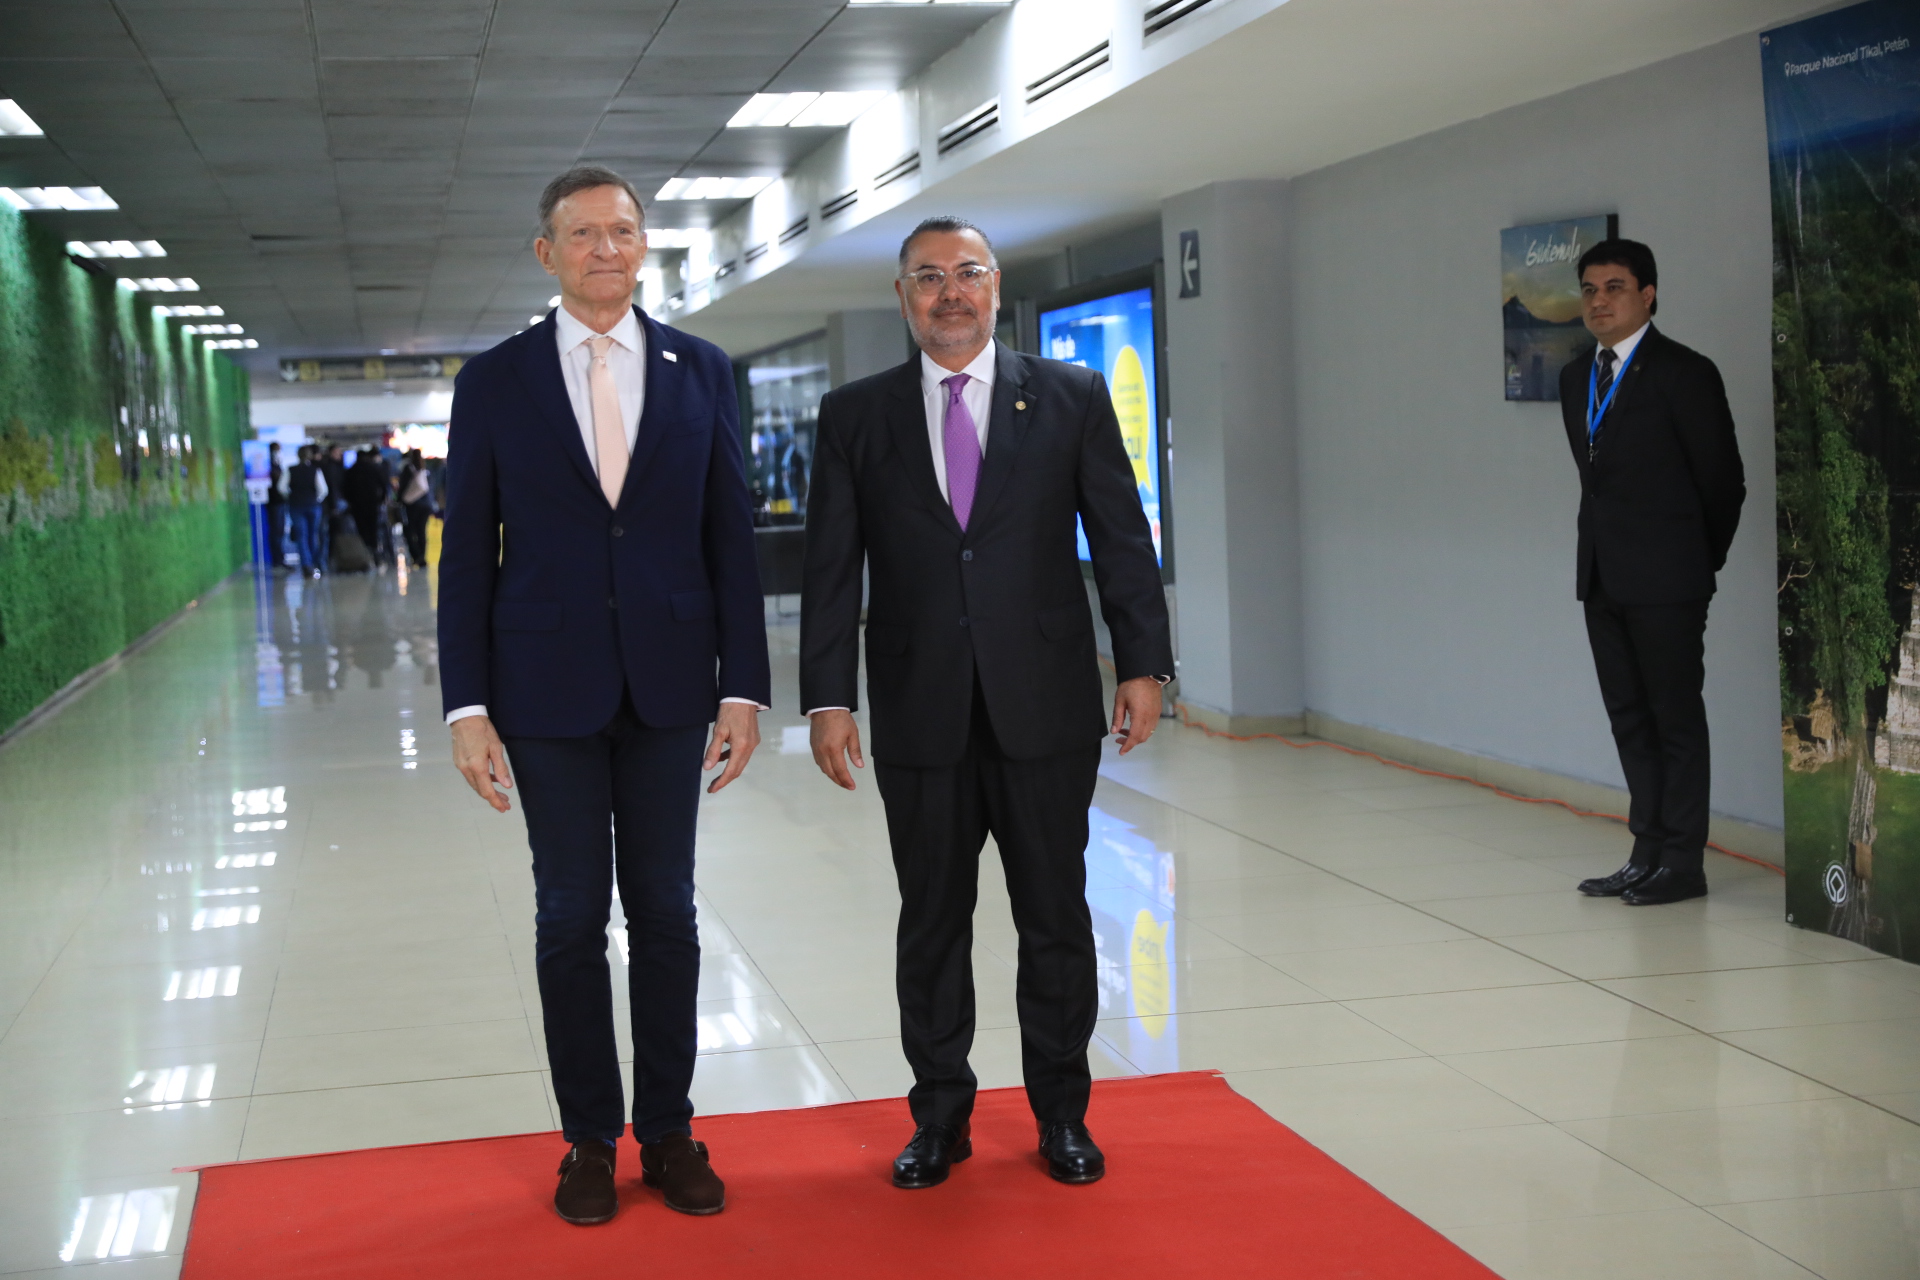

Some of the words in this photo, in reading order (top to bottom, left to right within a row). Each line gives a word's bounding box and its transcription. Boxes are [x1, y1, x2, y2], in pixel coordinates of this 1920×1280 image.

[1790, 59, 1821, 76] Parque
[1822, 47, 1859, 68] Nacional
[1860, 42, 1884, 59] Tikal,
[1884, 36, 1910, 53] Petén
[1525, 225, 1581, 267] Guatemala
